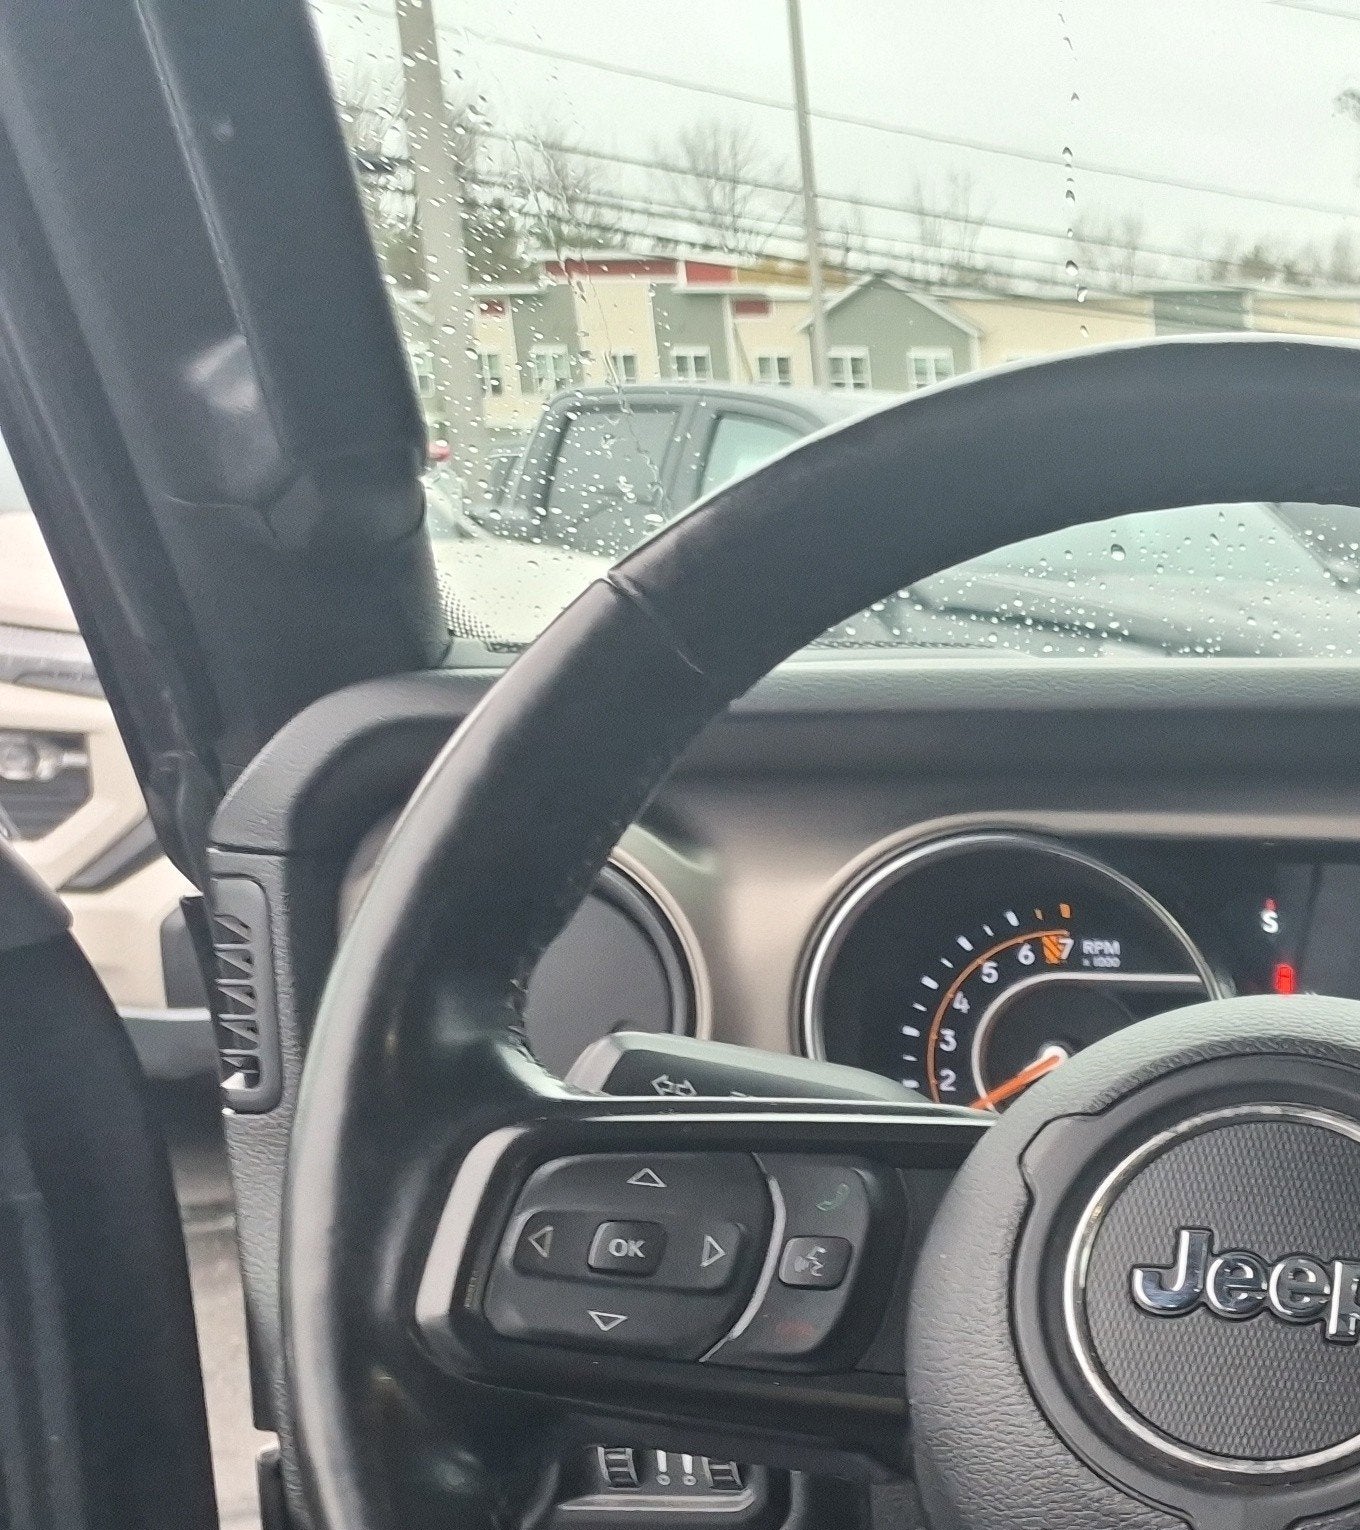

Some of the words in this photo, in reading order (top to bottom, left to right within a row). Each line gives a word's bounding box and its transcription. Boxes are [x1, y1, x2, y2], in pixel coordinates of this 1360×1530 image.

[1260, 909, 1279, 934] S
[1017, 942, 1035, 966] 6
[1058, 938, 1075, 960] 7
[1082, 940, 1121, 955] RPM
[981, 961, 999, 984] 5
[952, 990, 971, 1014] 4
[939, 1029, 957, 1052] 3
[939, 1070, 956, 1093] 2
[608, 1238, 646, 1260] OK
